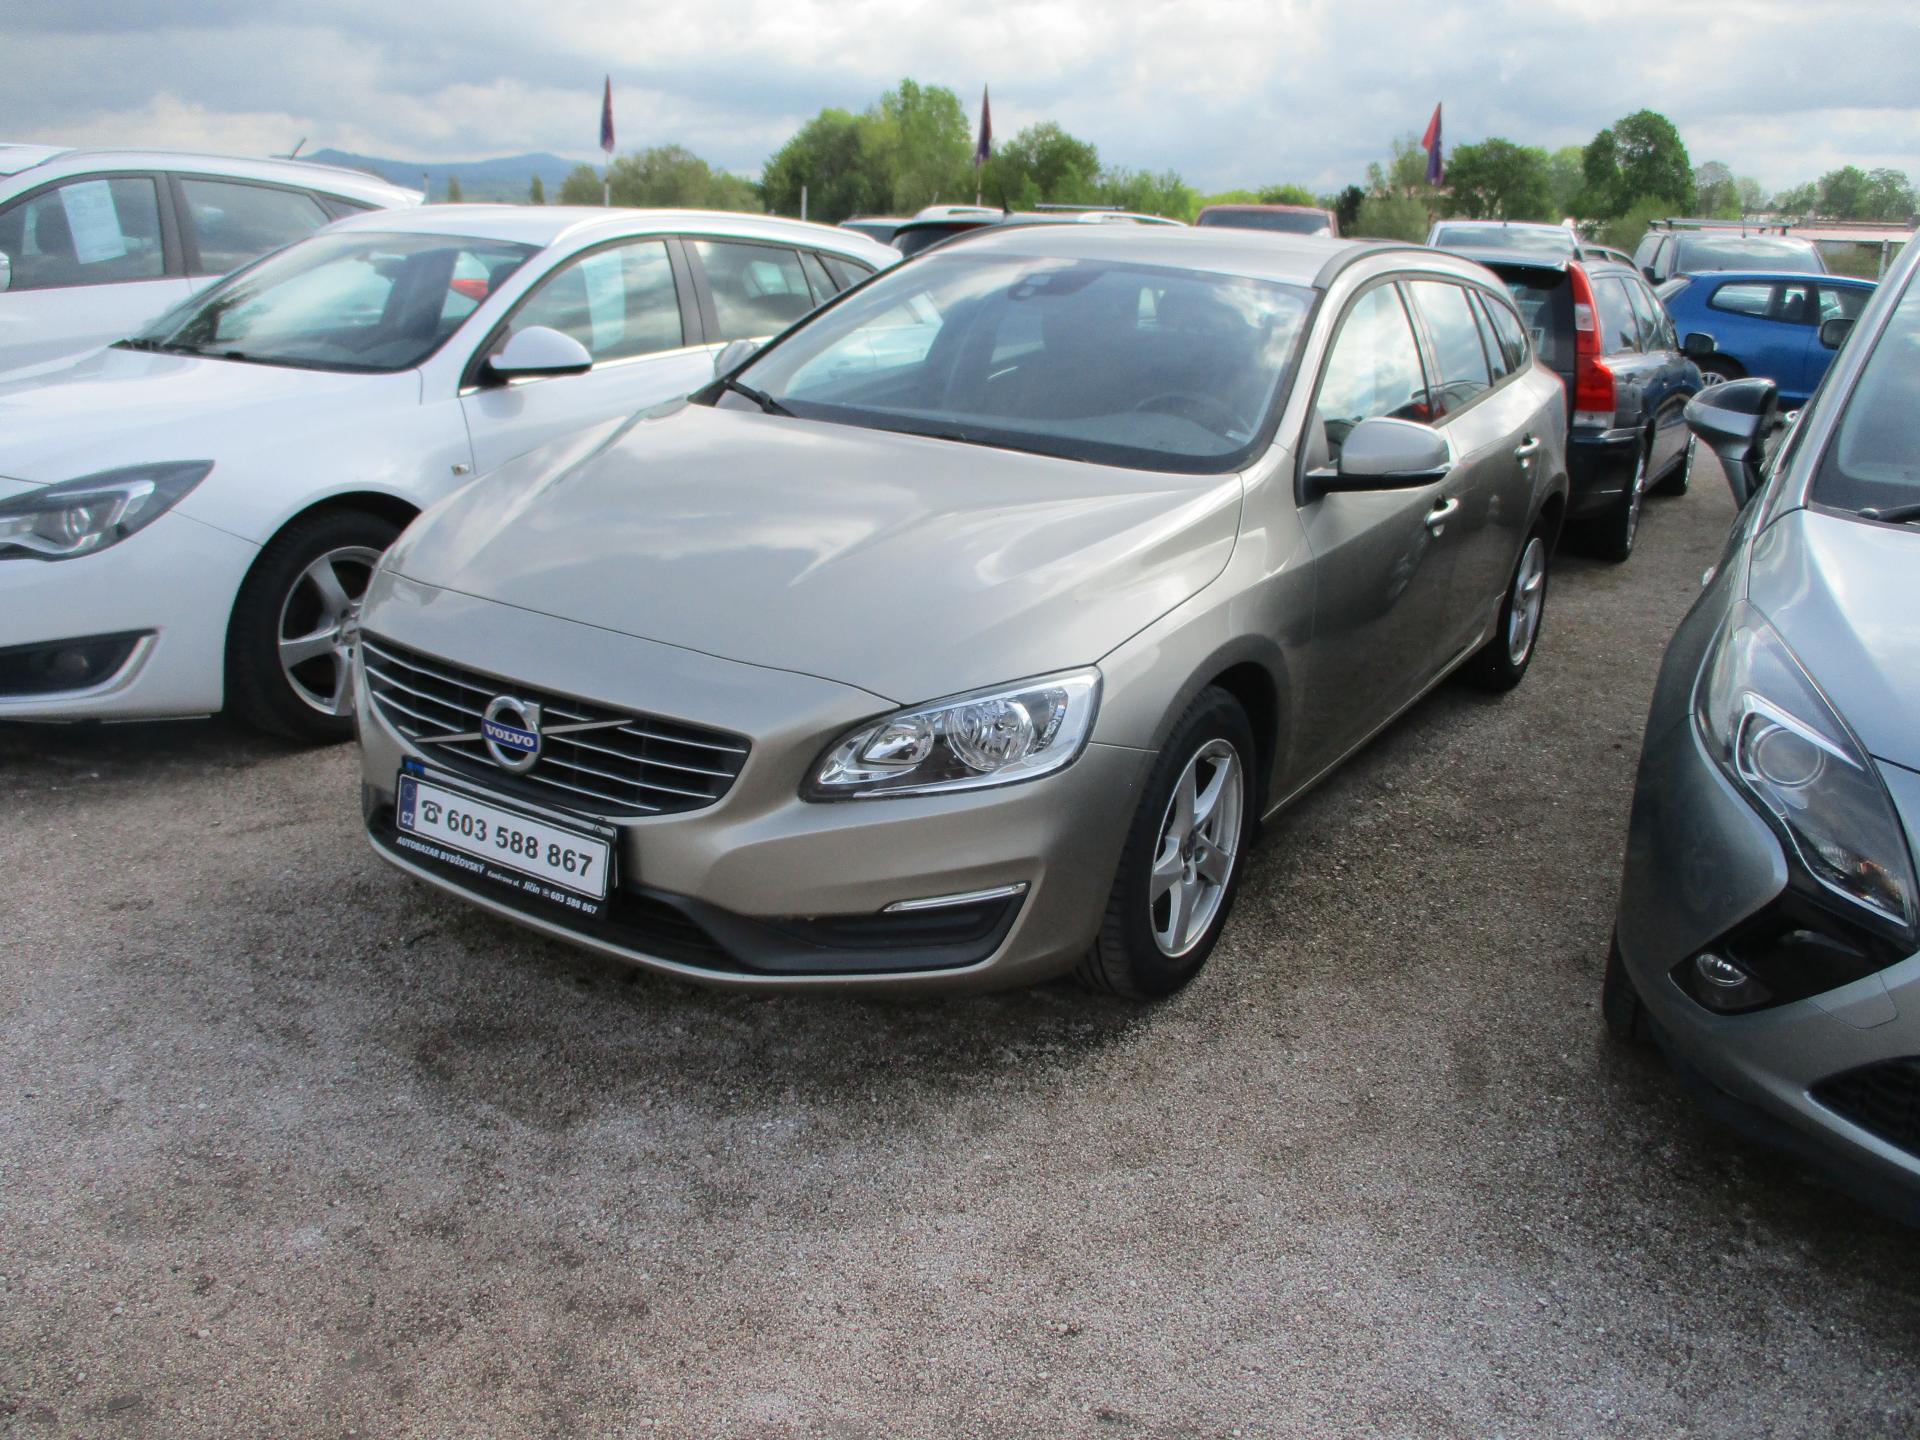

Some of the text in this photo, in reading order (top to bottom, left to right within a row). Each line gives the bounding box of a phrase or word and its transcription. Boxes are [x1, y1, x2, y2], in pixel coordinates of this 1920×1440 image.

[484, 723, 535, 747] VOLVO
[401, 811, 414, 827] CZ
[447, 809, 488, 842] 603
[495, 826, 539, 860] 588
[547, 843, 594, 878] 867
[395, 836, 440, 858] AUTOBAZAR
[550, 891, 565, 903] 603
[566, 896, 581, 909] 588
[581, 902, 598, 915] 867
